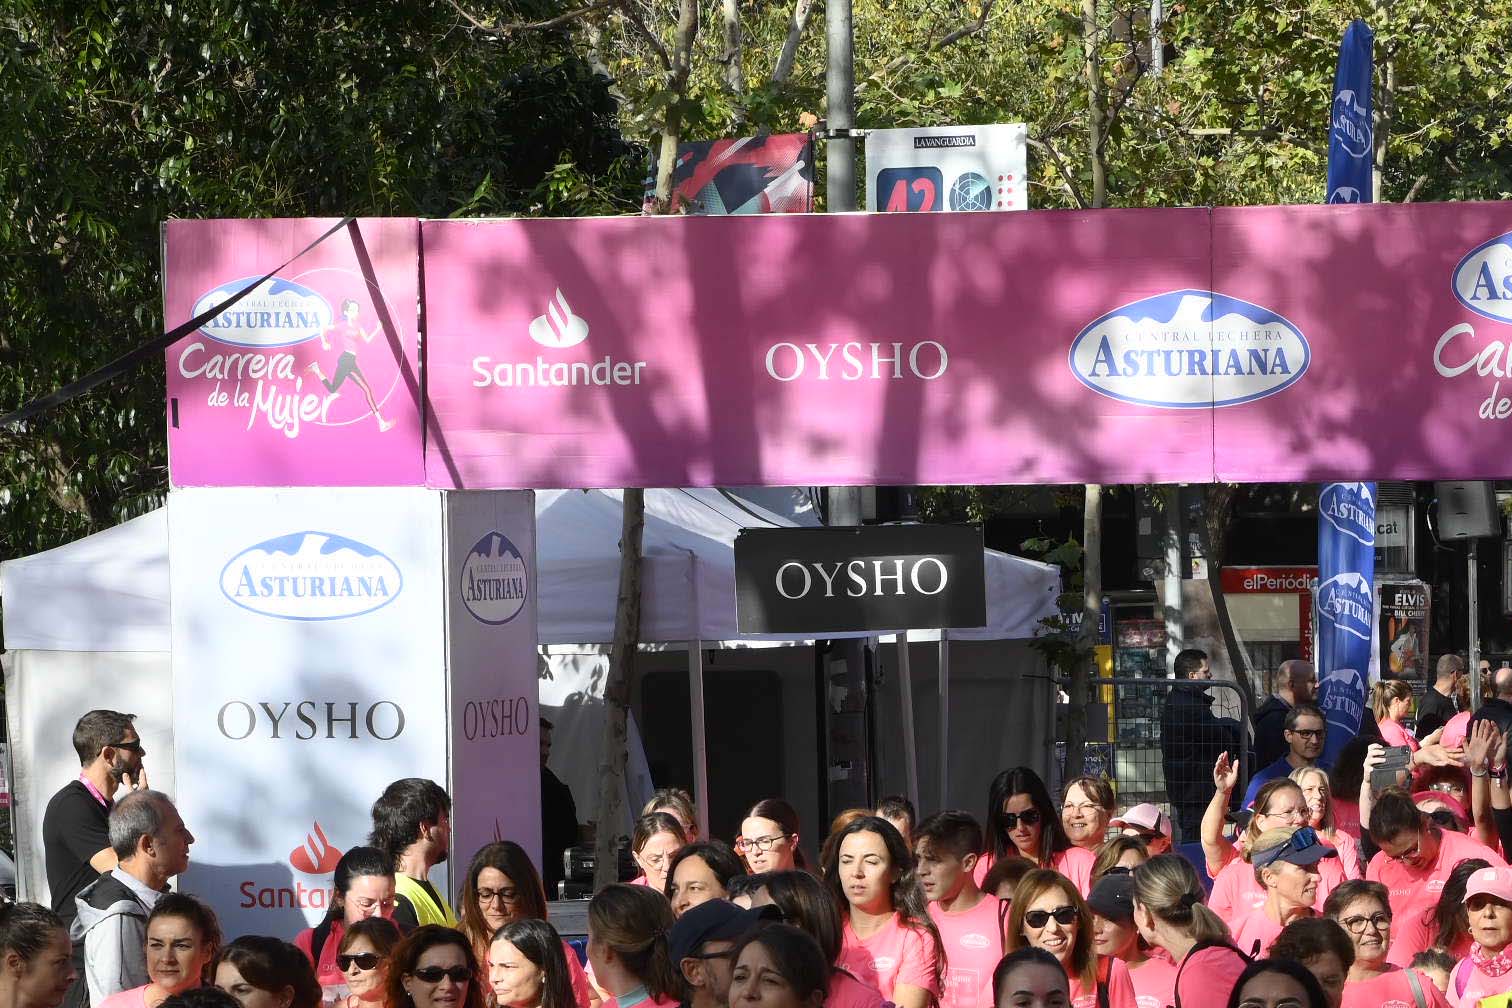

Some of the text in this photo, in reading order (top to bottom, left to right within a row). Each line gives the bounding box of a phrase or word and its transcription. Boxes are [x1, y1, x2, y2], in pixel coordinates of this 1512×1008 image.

[915, 136, 975, 148] LA VANGUARDIA
[178, 342, 296, 379] Carrera
[472, 354, 646, 388] Santander
[764, 340, 949, 382] OYSHO
[1087, 334, 1292, 379] ASTURIANA
[207, 380, 250, 407] de la
[247, 376, 341, 439] Mujer
[234, 563, 390, 597] ASTURIANA
[466, 569, 525, 602] ASTURIANA
[774, 557, 948, 601] OYSHO
[1394, 593, 1425, 606] ELVIS
[217, 700, 406, 740] OYSHO
[463, 696, 529, 740] OYSHO
